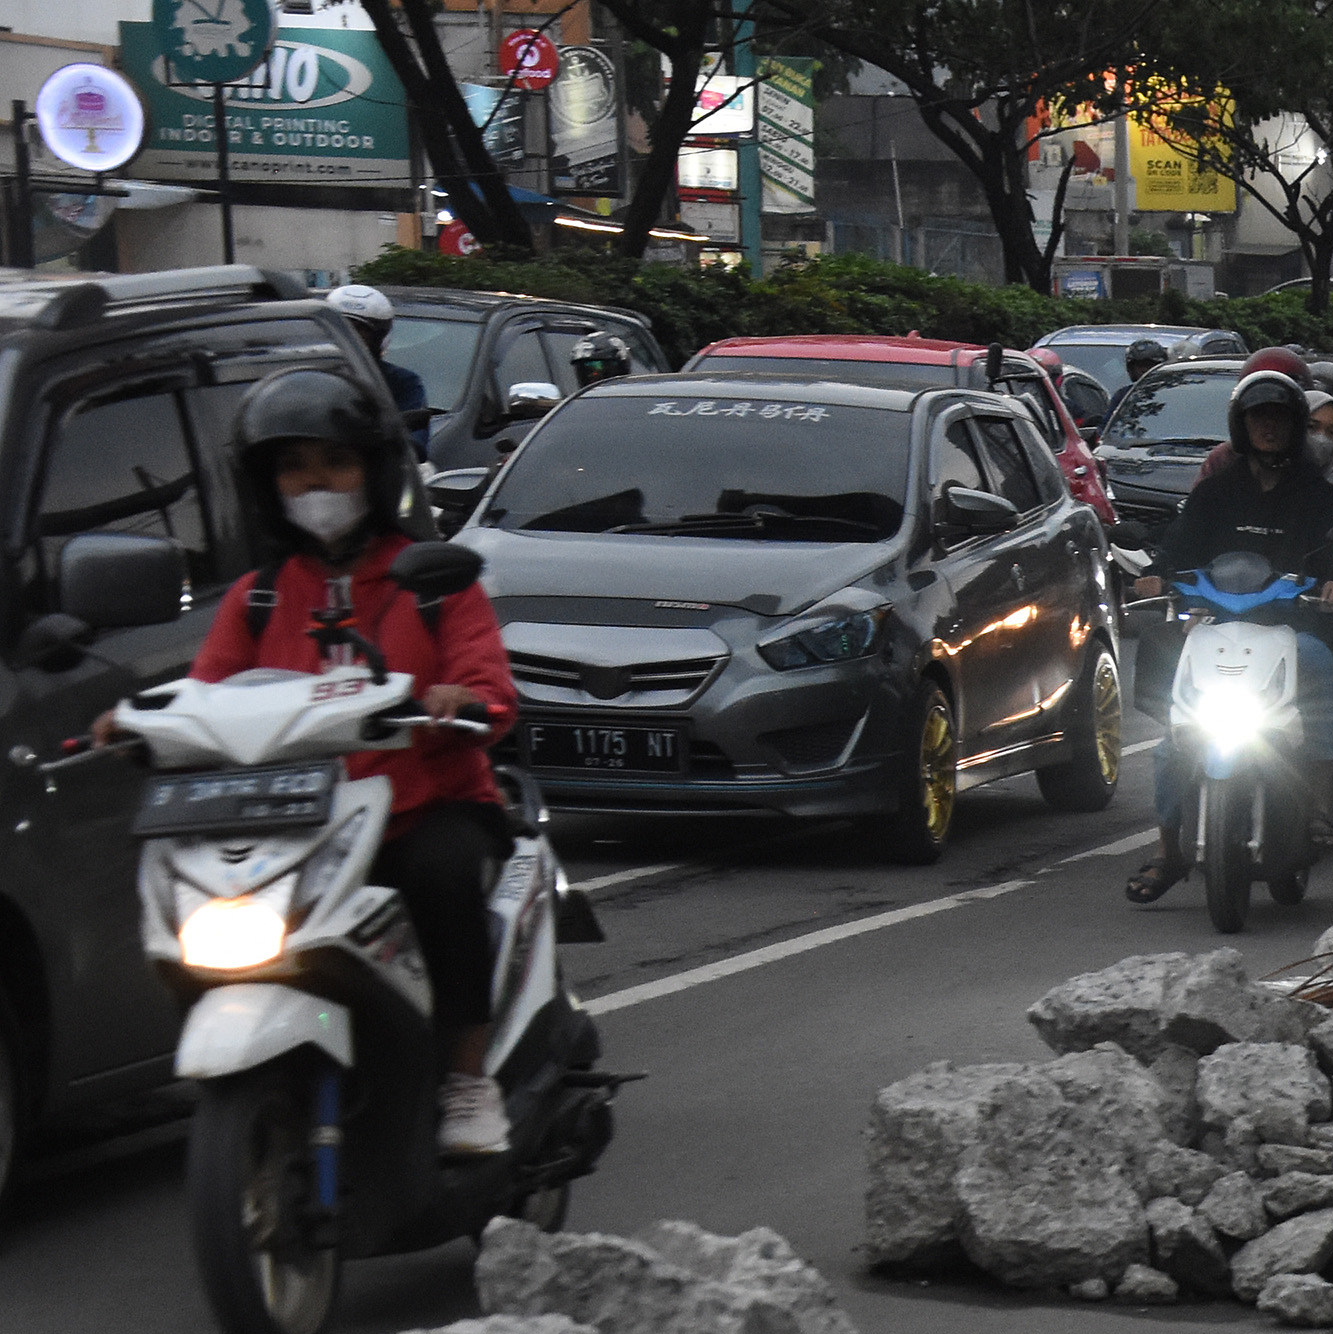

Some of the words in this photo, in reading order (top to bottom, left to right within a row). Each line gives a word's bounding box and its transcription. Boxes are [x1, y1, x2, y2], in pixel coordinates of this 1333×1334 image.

[183, 114, 255, 130] DIGTAL
[261, 116, 350, 134] PRINTING
[159, 127, 242, 144] INDOR
[252, 131, 264, 145] &
[273, 132, 375, 150] OUTDOOR
[184, 158, 351, 175] wwcanoprint.com
[1147, 160, 1182, 169] SCAN
[530, 727, 545, 750] F
[573, 728, 626, 755] 1175
[647, 732, 675, 757] NT
